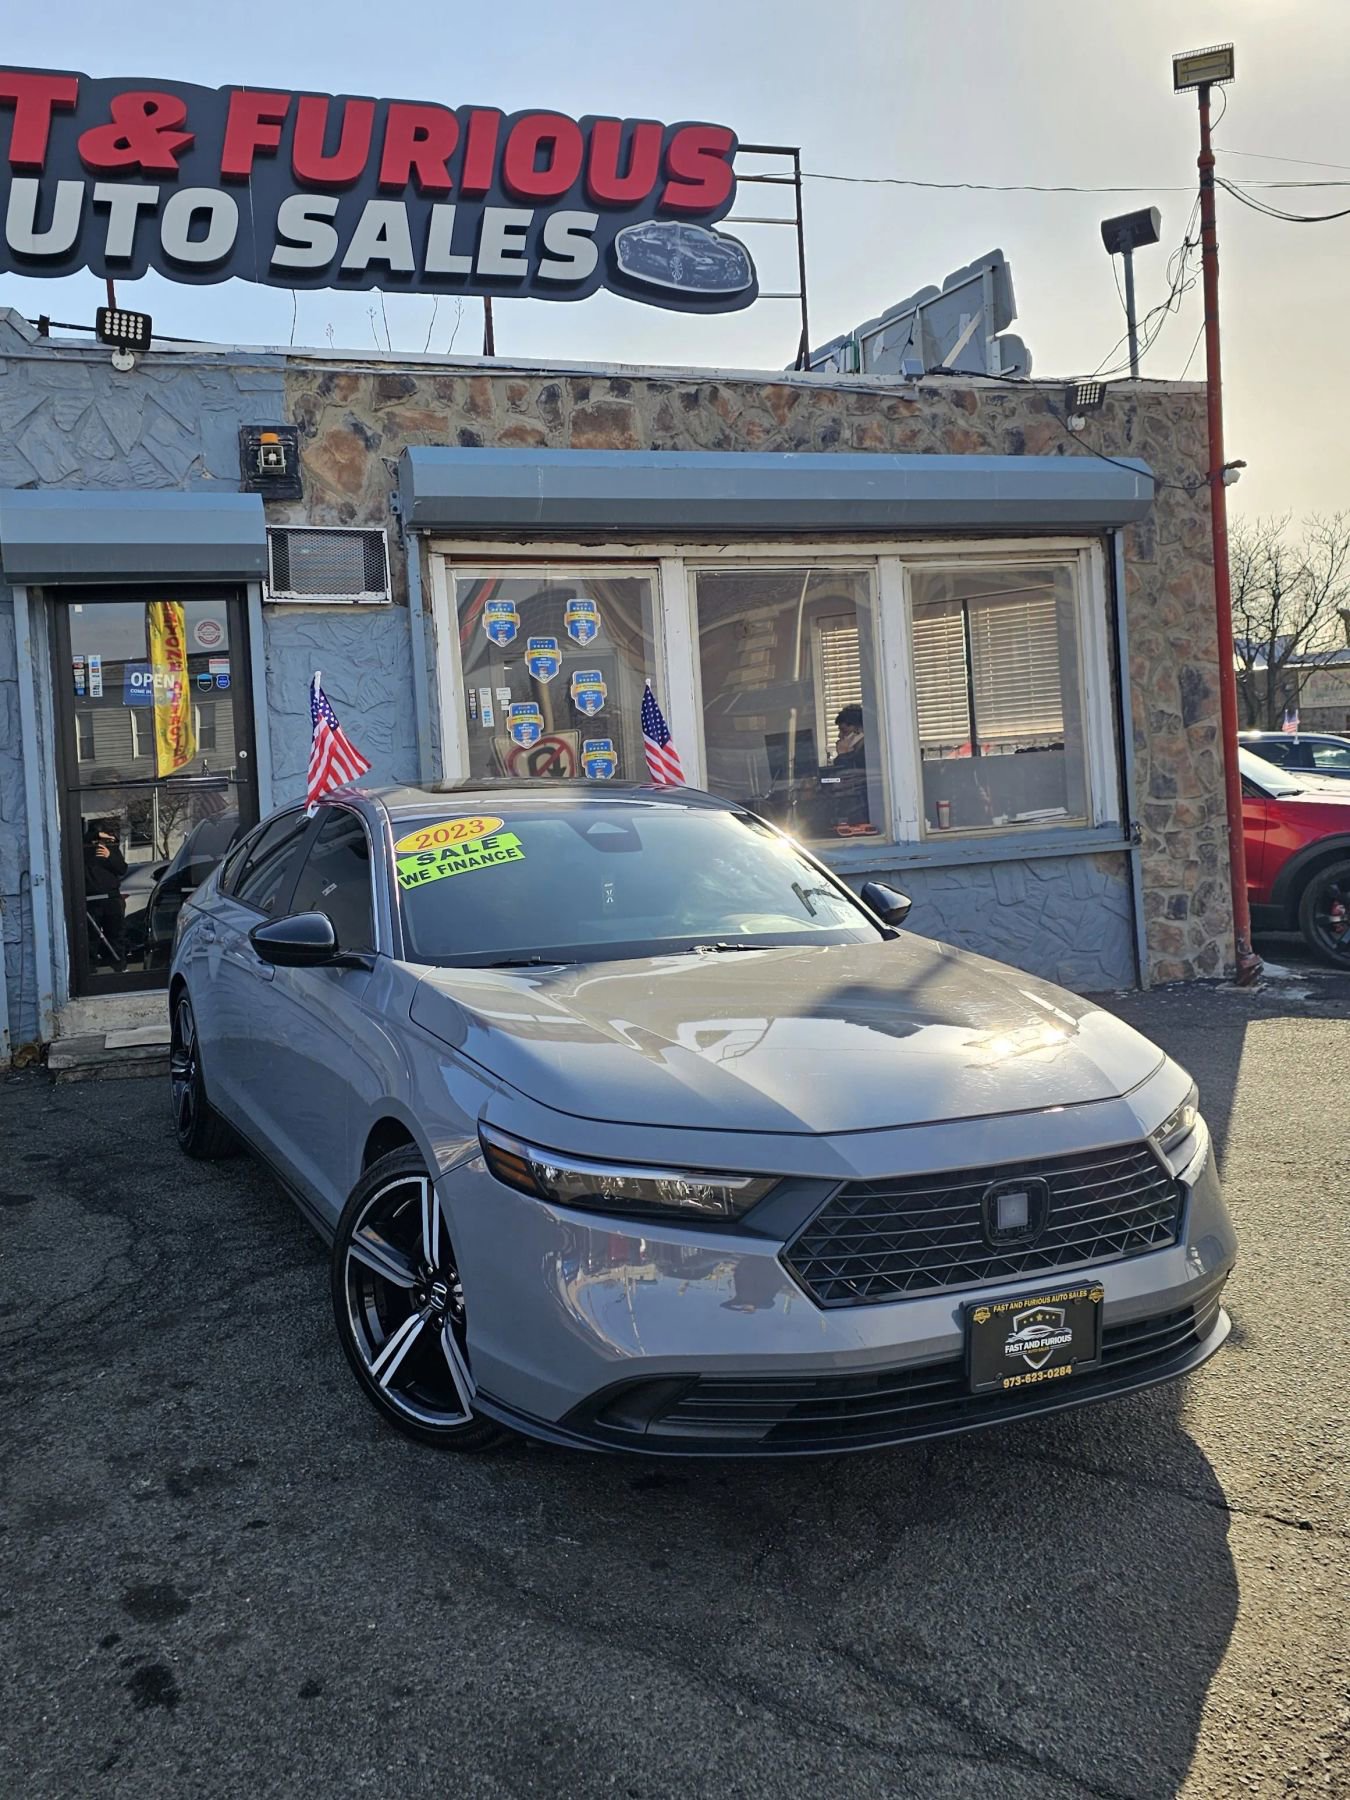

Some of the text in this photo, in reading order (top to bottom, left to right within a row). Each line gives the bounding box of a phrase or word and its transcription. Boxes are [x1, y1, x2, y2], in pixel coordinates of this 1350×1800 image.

[77, 90, 194, 174] &
[220, 89, 733, 212] FURIOUS
[270, 194, 600, 281] SALES
[130, 671, 176, 689] OPEN
[415, 819, 486, 850] 2023
[400, 848, 519, 886] WE FINANCE
[416, 836, 500, 867] SALE
[993, 1289, 1088, 1313] FAST AND FURIOUS AUTO SALES
[1004, 1334, 1072, 1354] FAST AND FURIOUS
[1003, 1365, 1073, 1389] 973-623-0284
